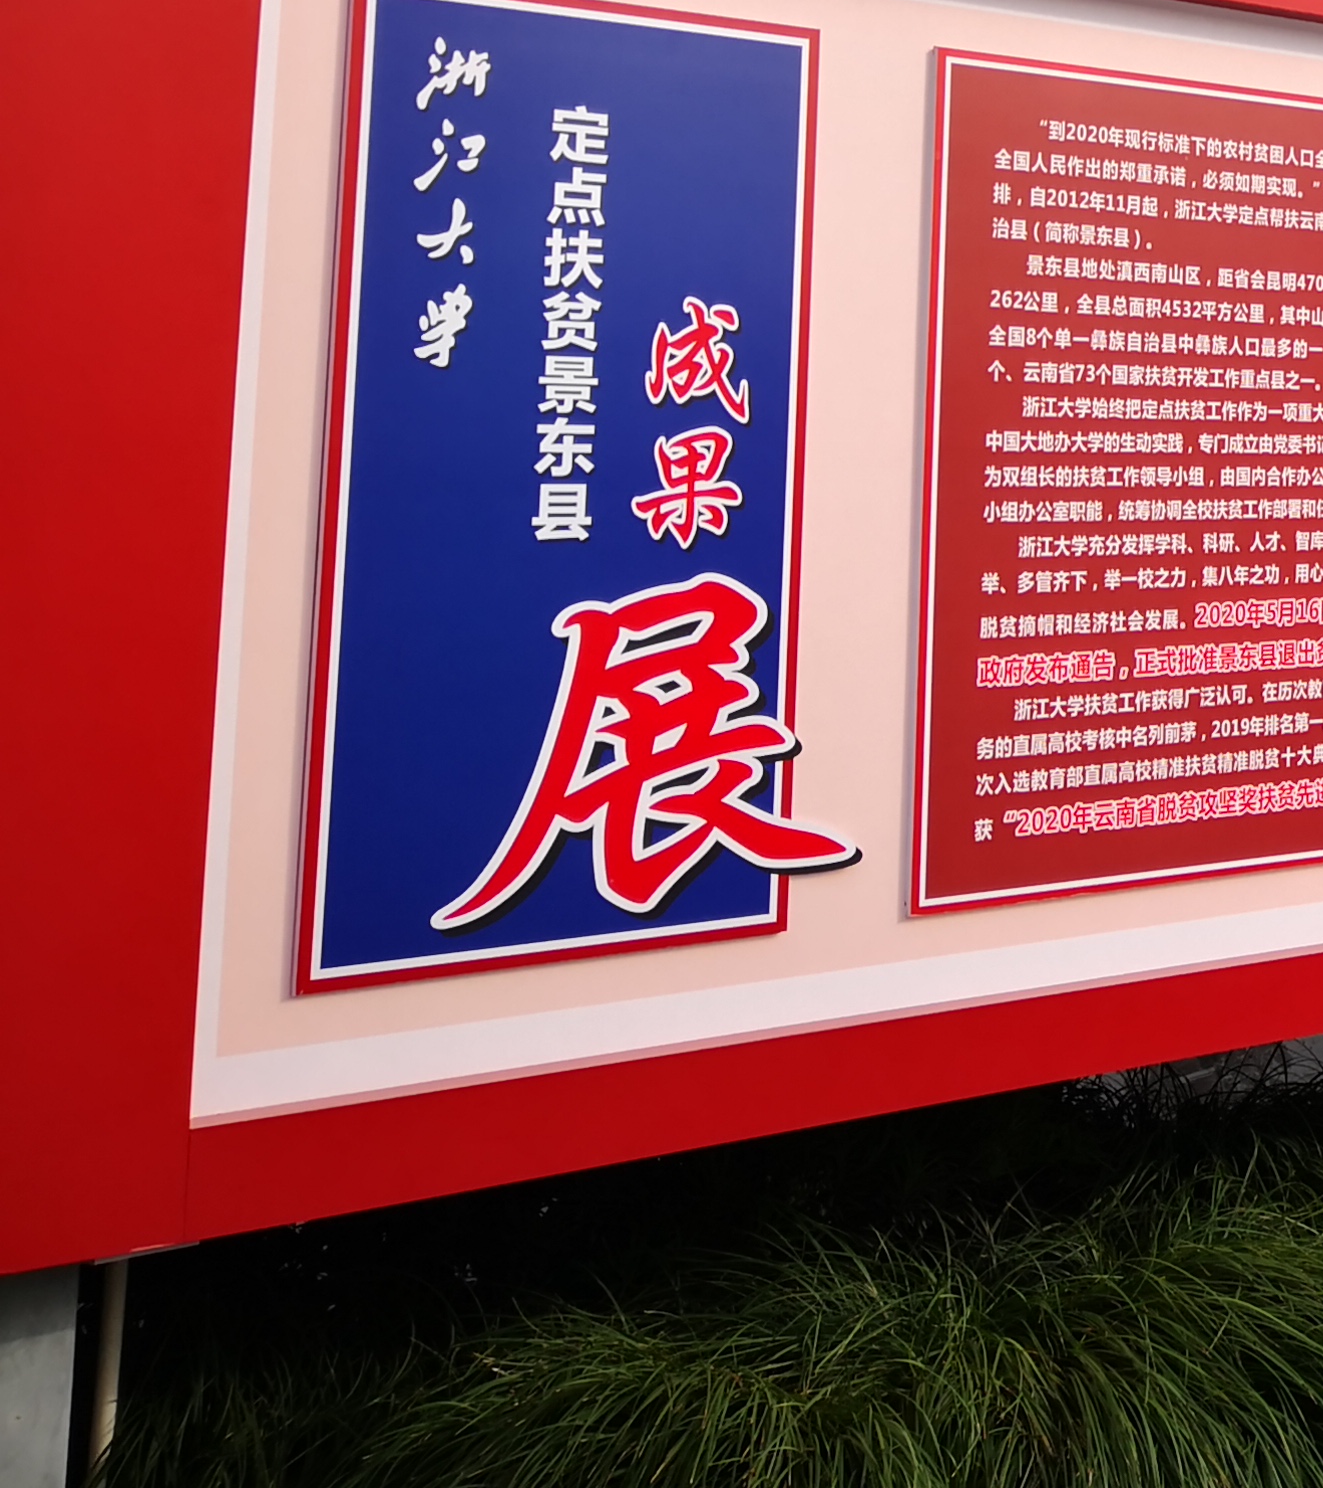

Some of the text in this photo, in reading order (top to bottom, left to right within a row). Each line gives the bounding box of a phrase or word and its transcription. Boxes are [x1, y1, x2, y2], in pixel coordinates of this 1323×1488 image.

[413, 37, 491, 367] 浙江大学
[530, 105, 610, 543] 定点扶贫景东县
